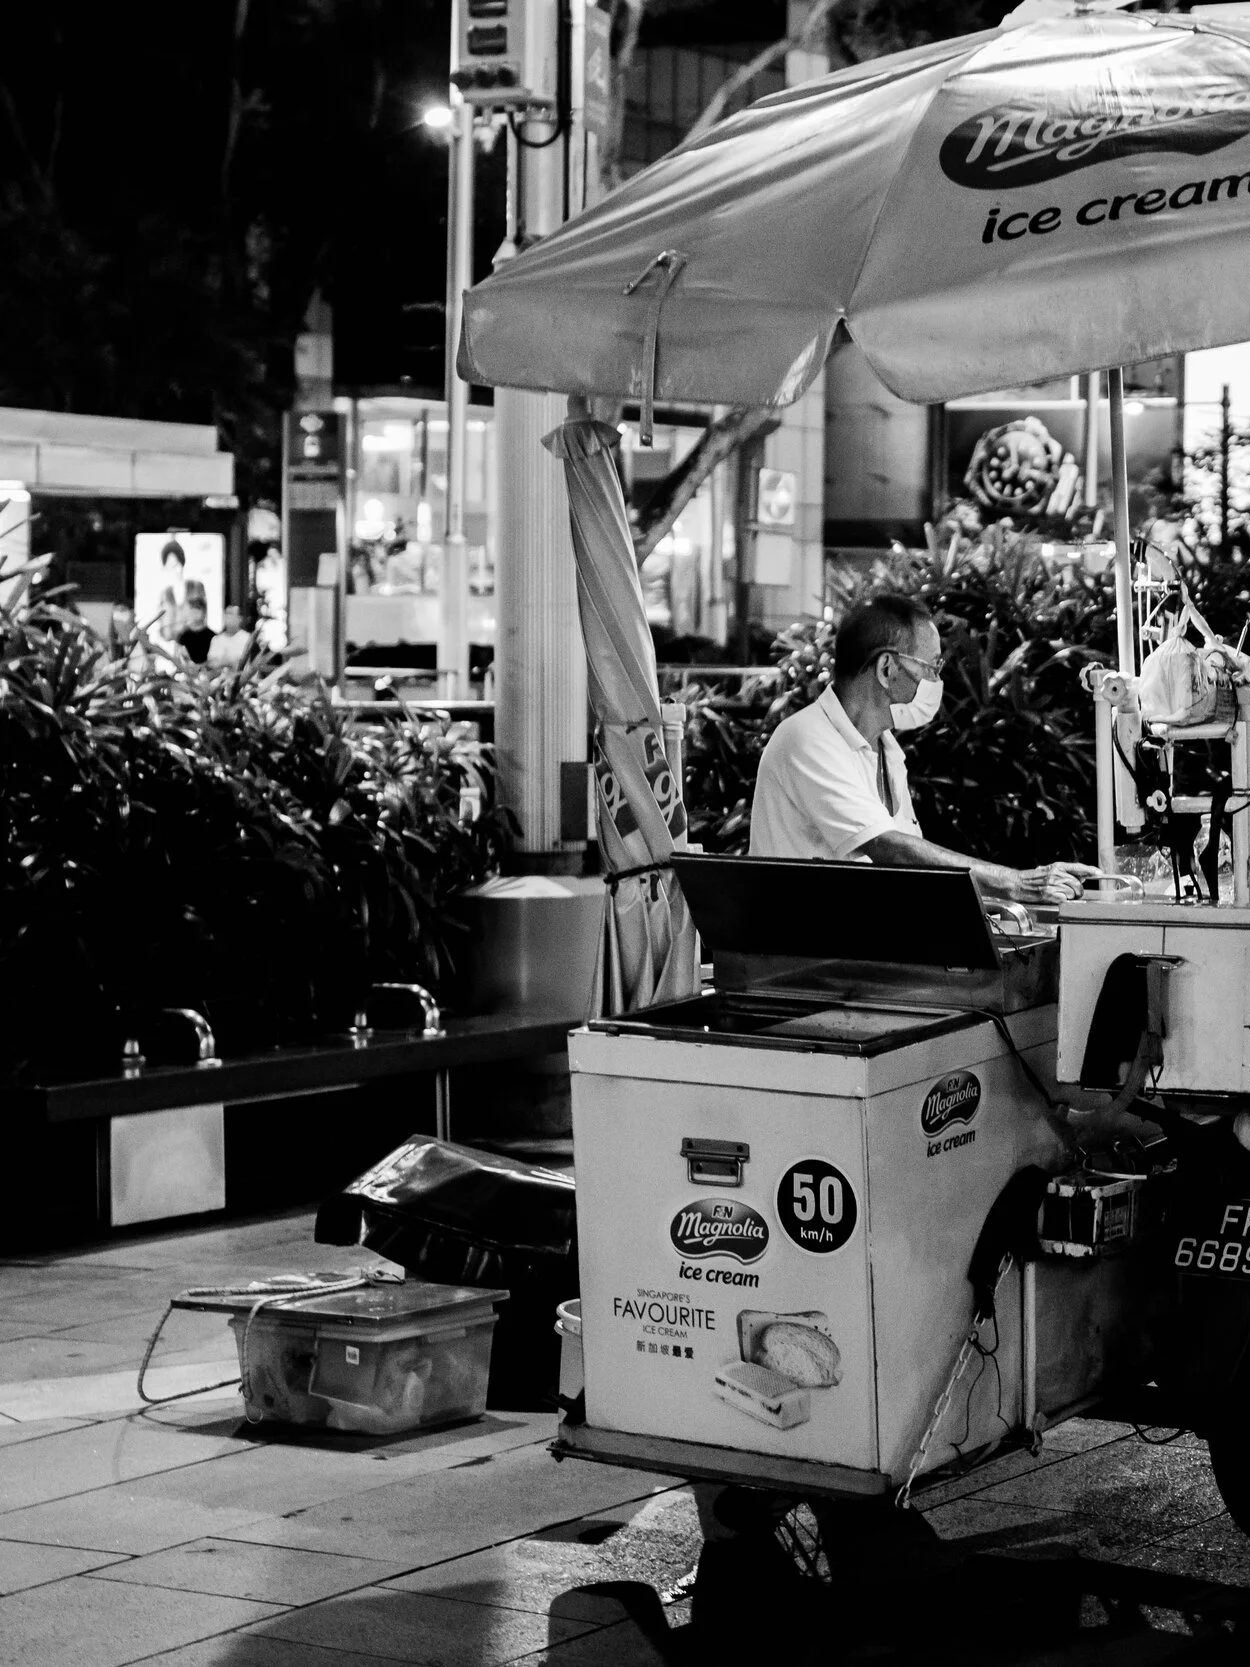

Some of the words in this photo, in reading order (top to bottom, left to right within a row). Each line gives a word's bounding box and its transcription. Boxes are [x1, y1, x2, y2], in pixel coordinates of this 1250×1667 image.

[981, 207, 1062, 244] ice
[925, 1081, 978, 1125] Magnolia
[927, 1141, 942, 1158] ice
[943, 1130, 976, 1152] cream
[793, 1172, 843, 1225] 50
[677, 1211, 765, 1246] Magnolia
[800, 1226, 833, 1242] km/h
[679, 1261, 703, 1280] ice
[705, 1268, 760, 1288] cream
[637, 1288, 690, 1303] SINGAPORE'S
[613, 1297, 716, 1330] FAVOURITE
[643, 1324, 656, 1335] ICE
[657, 1326, 688, 1339] CREAM
